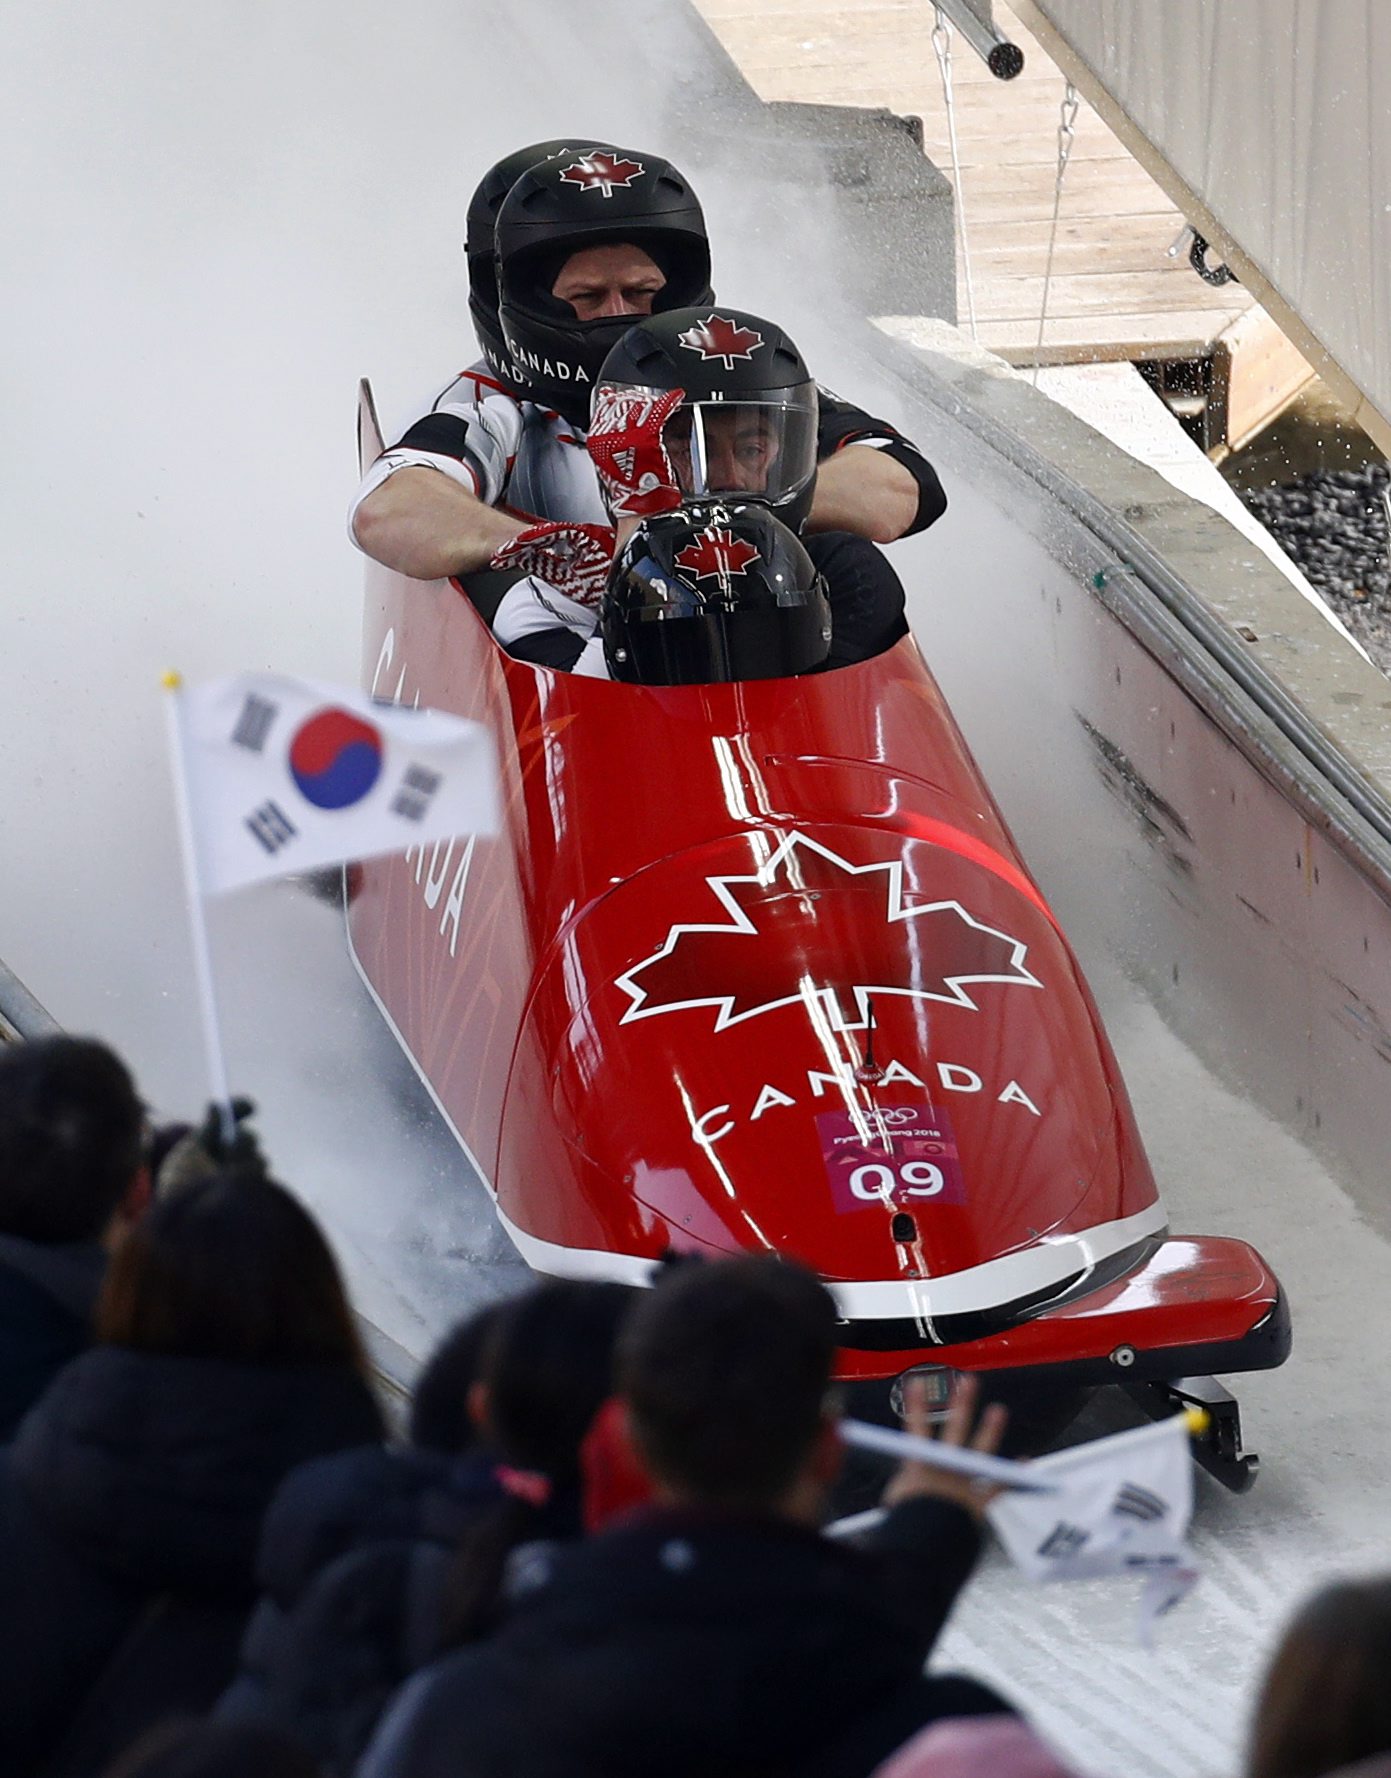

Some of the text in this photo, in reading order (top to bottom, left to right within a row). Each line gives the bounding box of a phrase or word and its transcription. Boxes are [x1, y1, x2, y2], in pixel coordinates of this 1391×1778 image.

[482, 342, 533, 388] ANAD
[510, 338, 590, 383] CANADA
[692, 1059, 1041, 1145] CANADA
